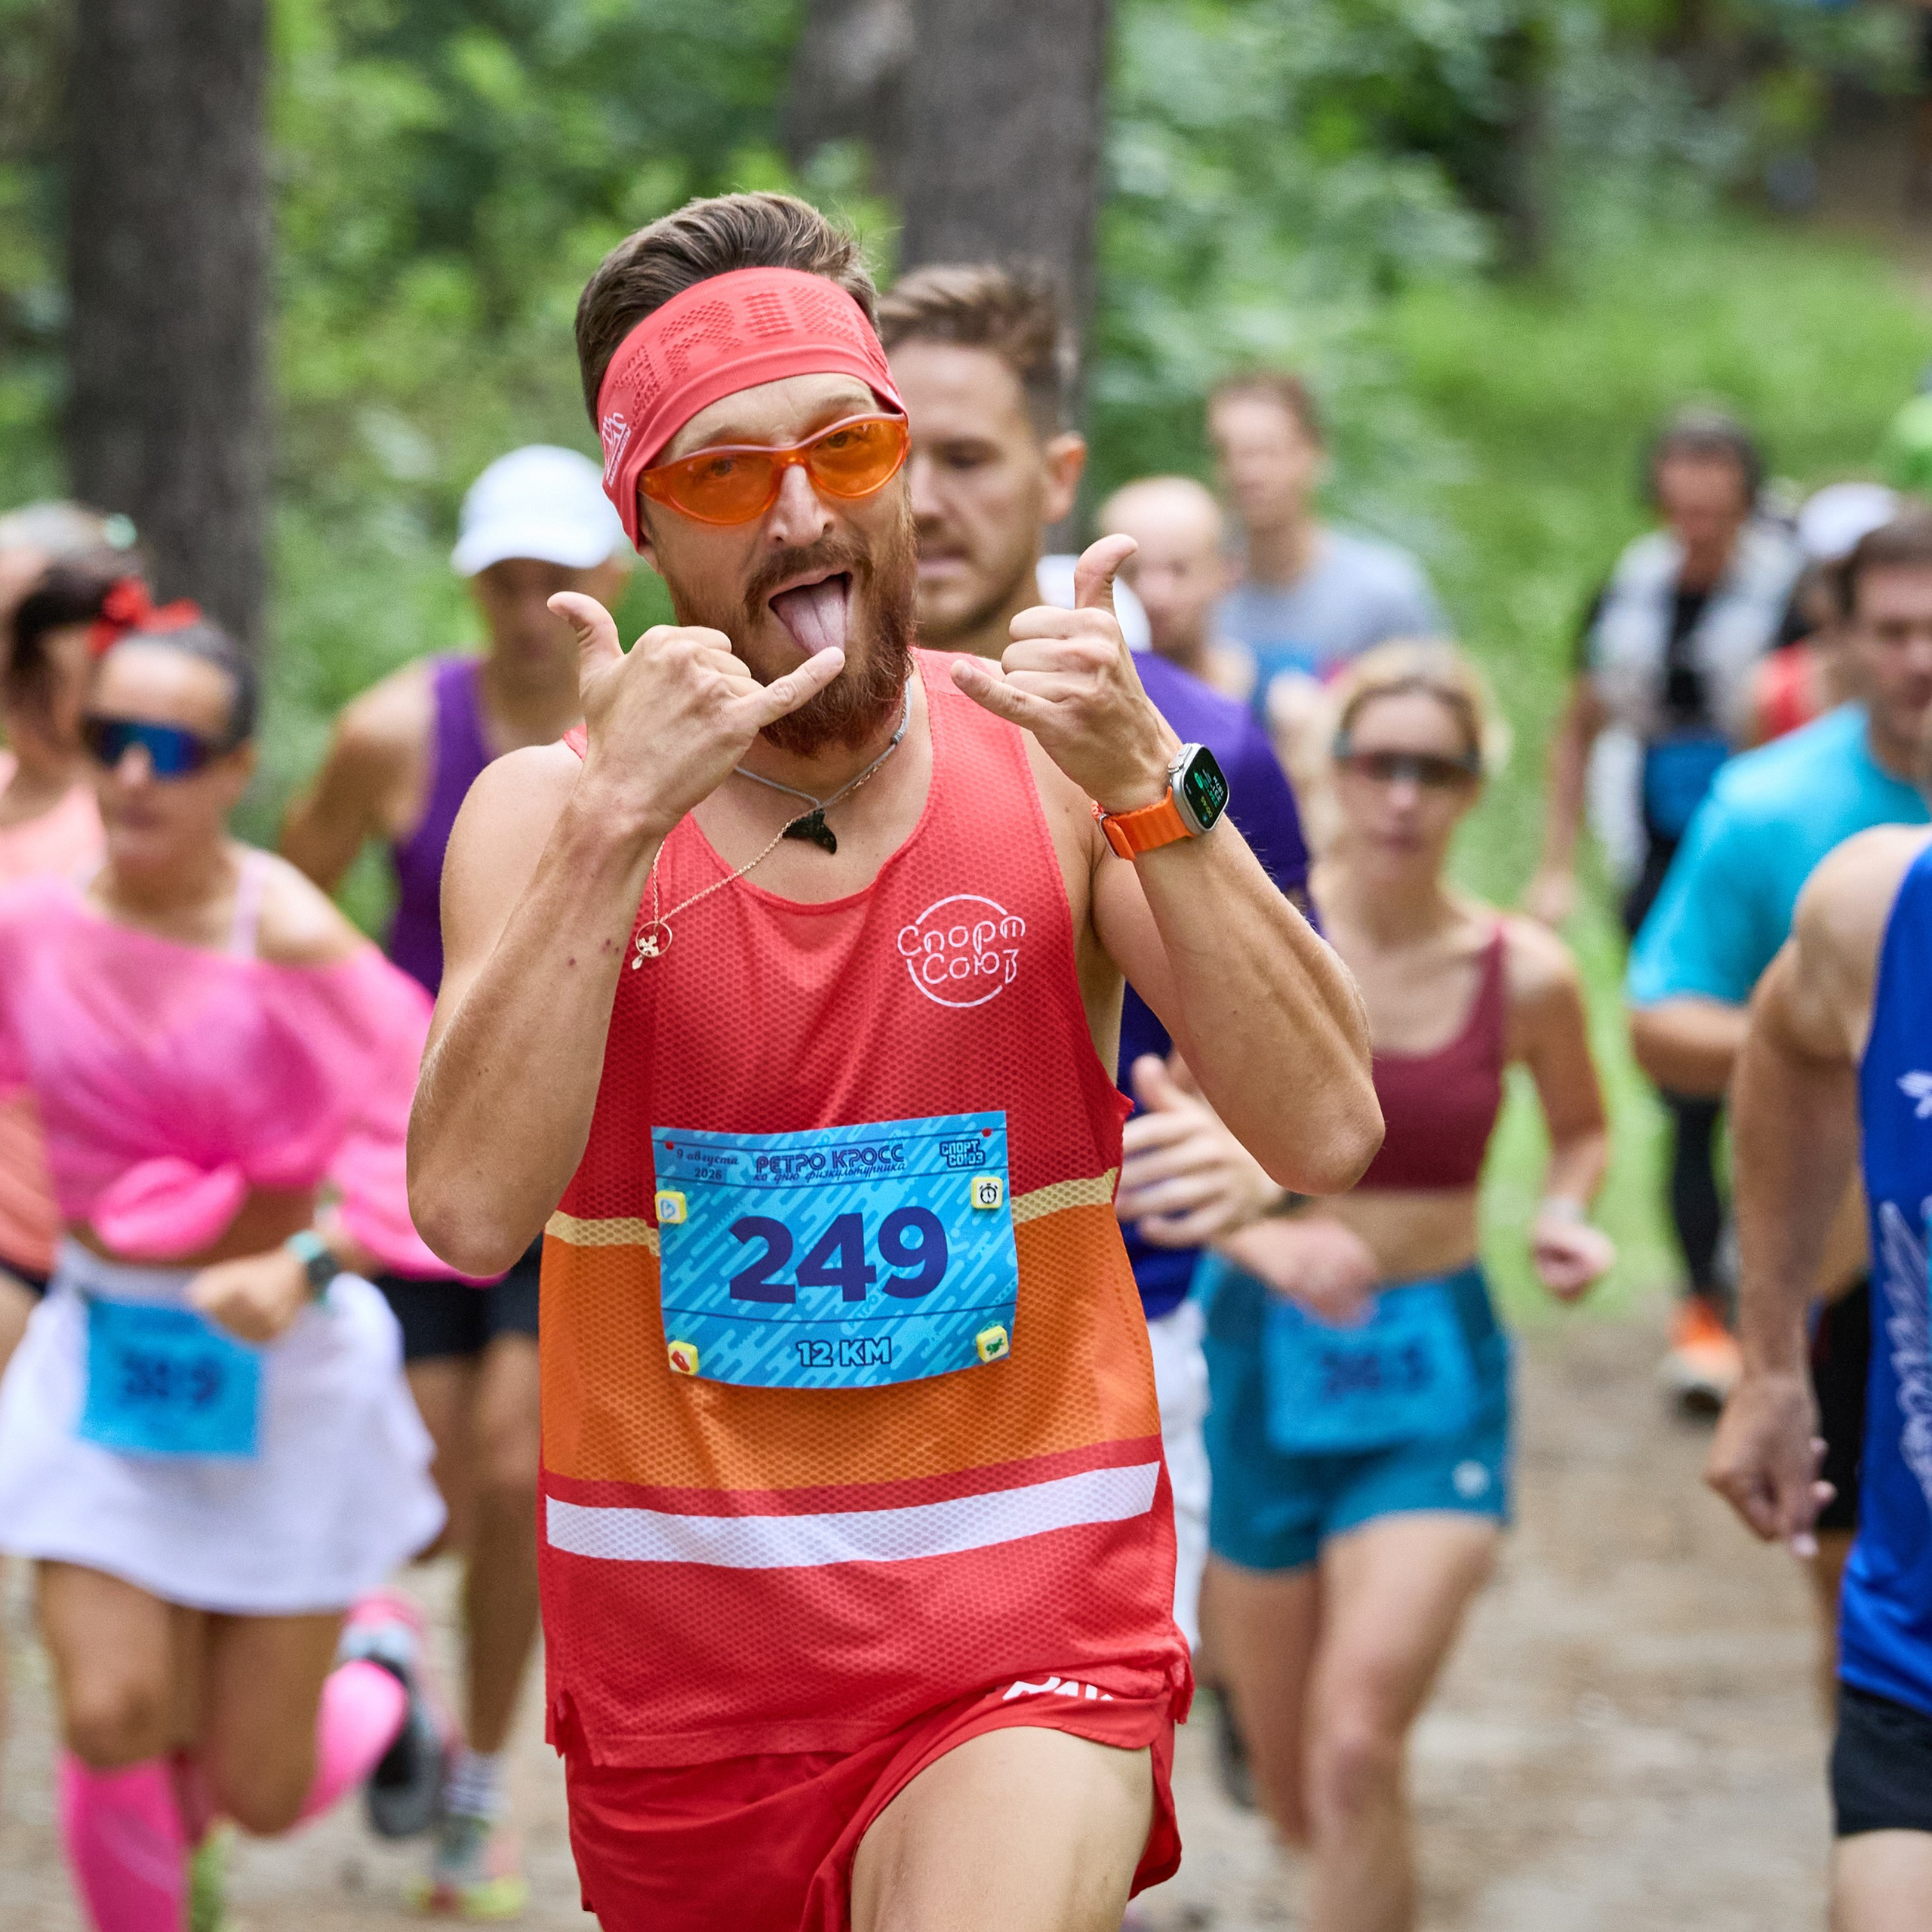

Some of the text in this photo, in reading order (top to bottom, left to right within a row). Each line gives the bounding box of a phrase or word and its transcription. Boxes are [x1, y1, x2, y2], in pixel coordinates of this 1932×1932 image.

[897, 916, 1026, 955] Спорт
[922, 949, 1020, 984] Союз
[677, 1149, 739, 1166] 9 августа
[756, 1144, 905, 1174] РЕТРО КРОСС
[940, 1139, 980, 1156] СПОРТ
[728, 1206, 949, 1304] 249
[795, 1339, 834, 1367] 12
